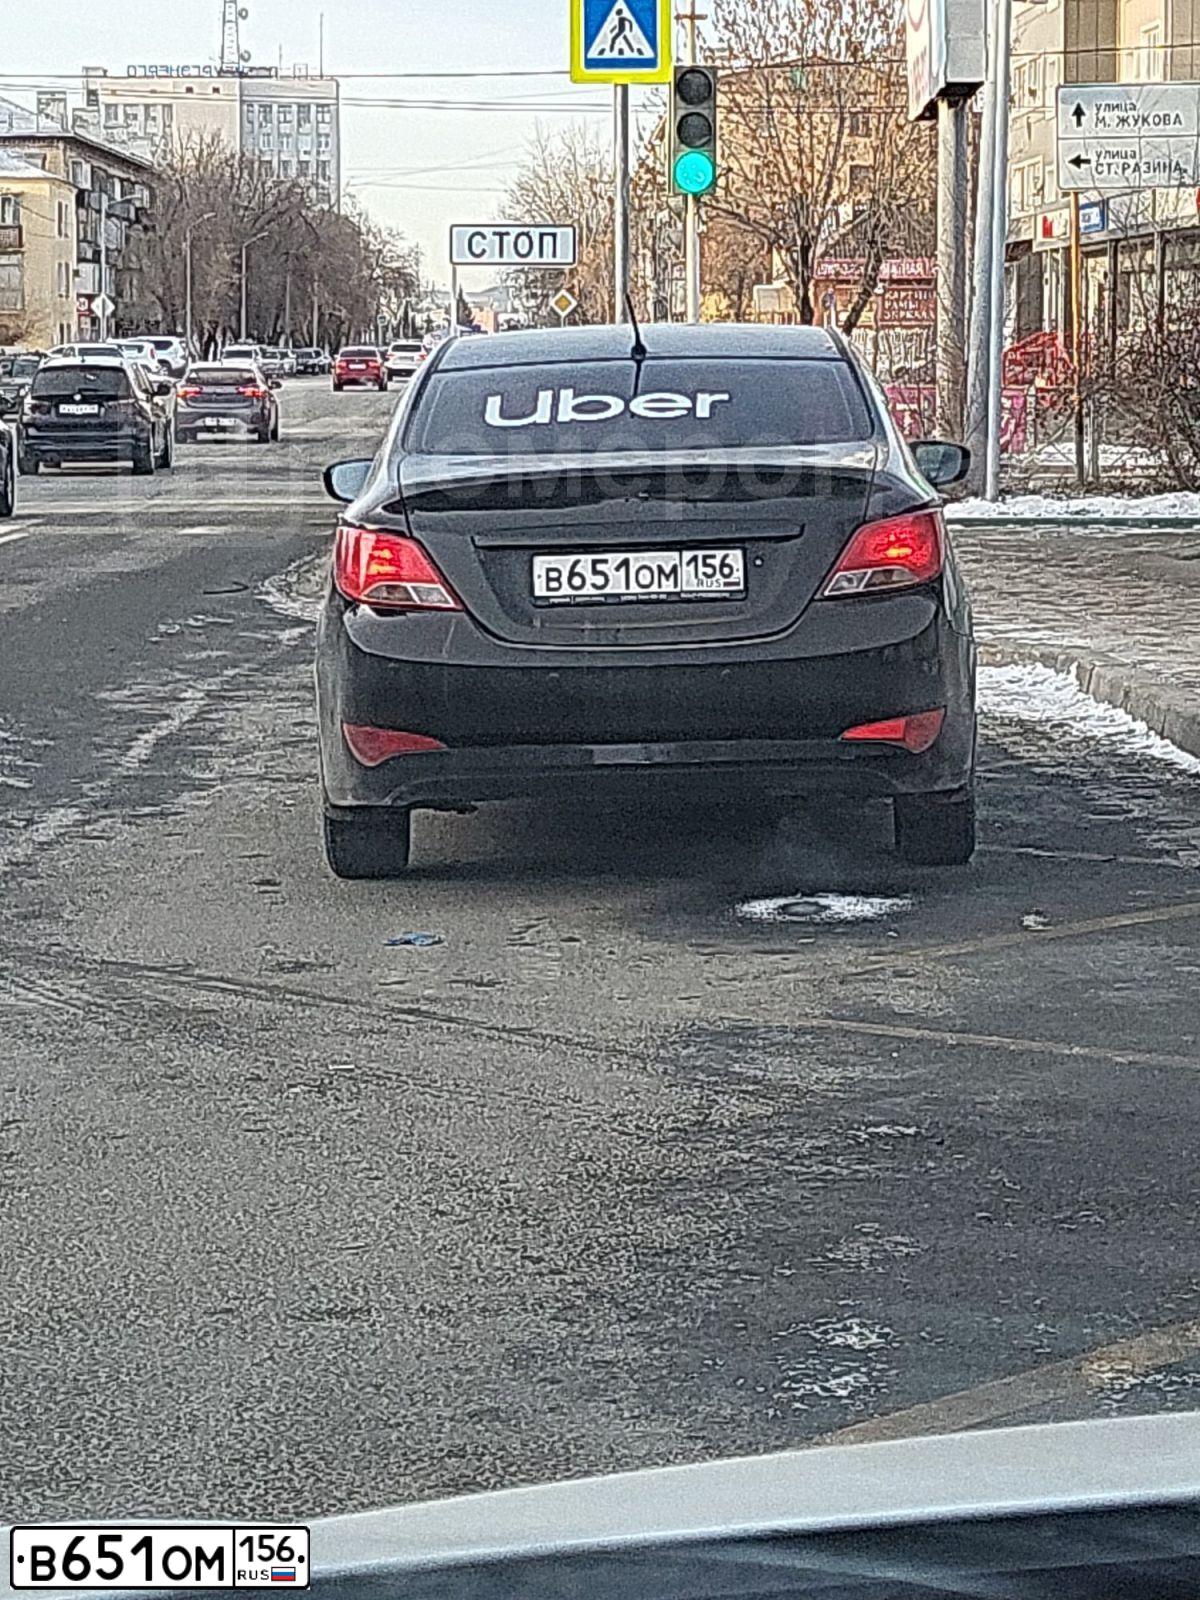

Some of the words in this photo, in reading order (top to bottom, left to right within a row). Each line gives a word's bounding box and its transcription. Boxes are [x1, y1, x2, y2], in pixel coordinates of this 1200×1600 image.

[1095, 102, 1137, 116] улица
[1116, 113, 1182, 127] ЖУКОВА
[1095, 150, 1137, 164] улица
[1122, 160, 1181, 175] РАЗИНА
[467, 231, 558, 259] СТОП
[686, 553, 735, 579] 156
[697, 578, 722, 588] RUS
